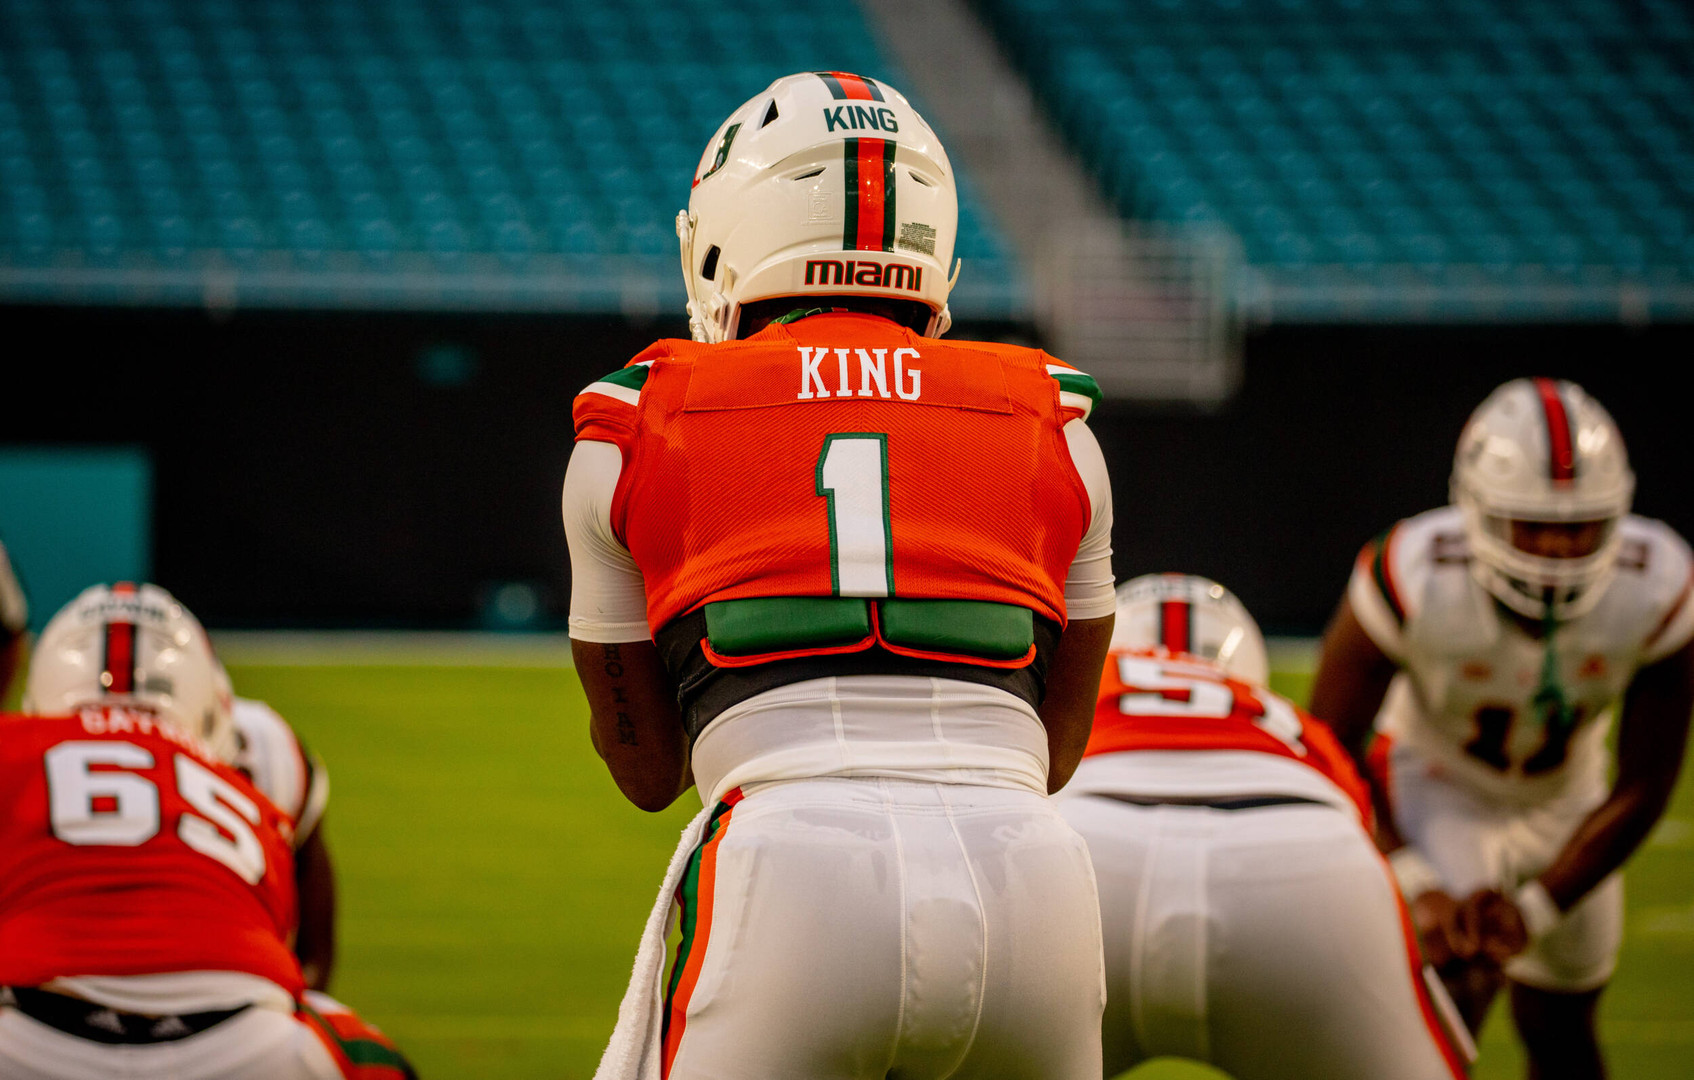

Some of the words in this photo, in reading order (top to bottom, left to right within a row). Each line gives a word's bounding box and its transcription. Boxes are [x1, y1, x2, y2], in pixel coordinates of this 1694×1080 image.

[823, 105, 899, 134] KING
[796, 346, 922, 401] KING
[815, 432, 896, 598] 1
[44, 741, 267, 886] 65
